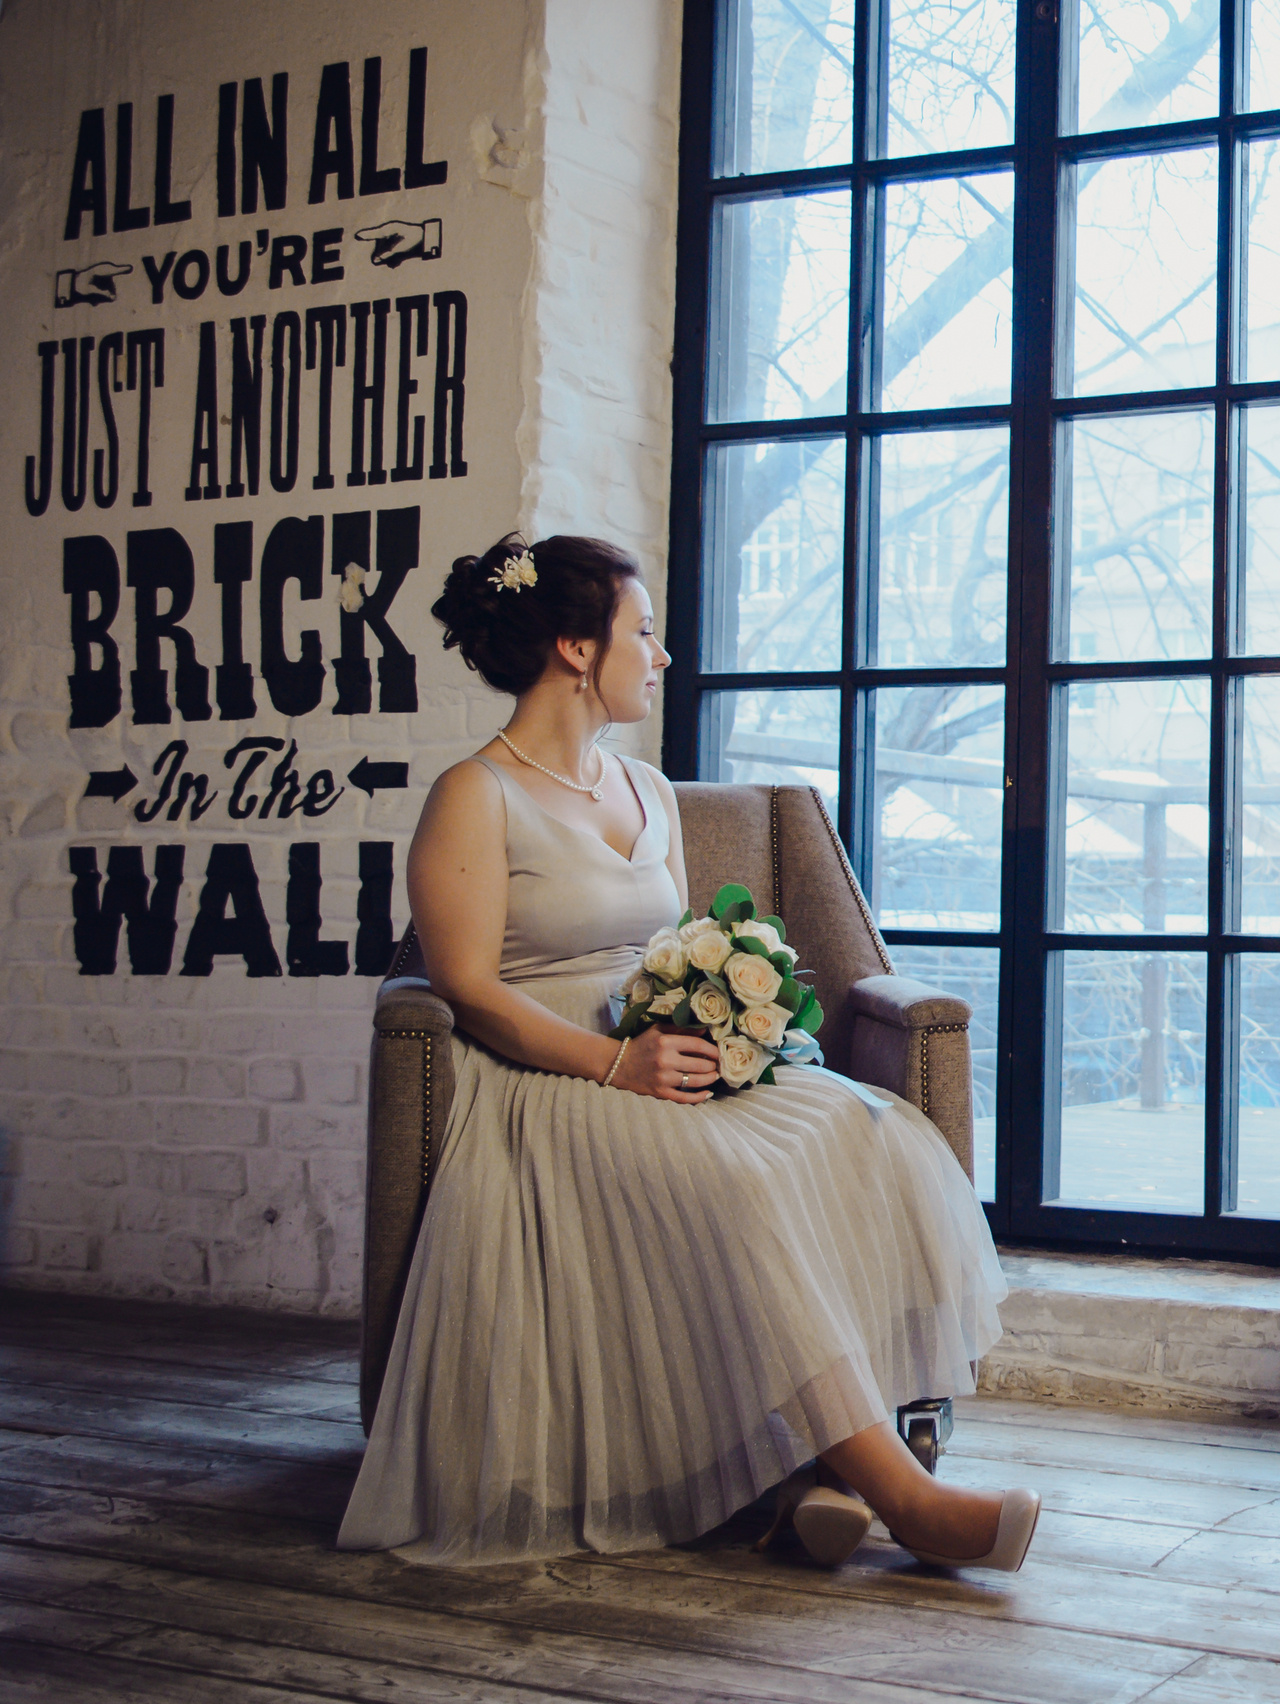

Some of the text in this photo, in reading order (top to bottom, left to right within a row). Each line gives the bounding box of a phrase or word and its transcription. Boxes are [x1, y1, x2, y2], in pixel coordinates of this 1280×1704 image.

[64, 47, 447, 240] ALL IN ALL
[142, 228, 345, 303] YOU'RE
[25, 290, 468, 517] JUST ANOTHER
[63, 505, 421, 729] BRICK
[134, 736, 346, 823] In The
[69, 841, 402, 978] WALL
